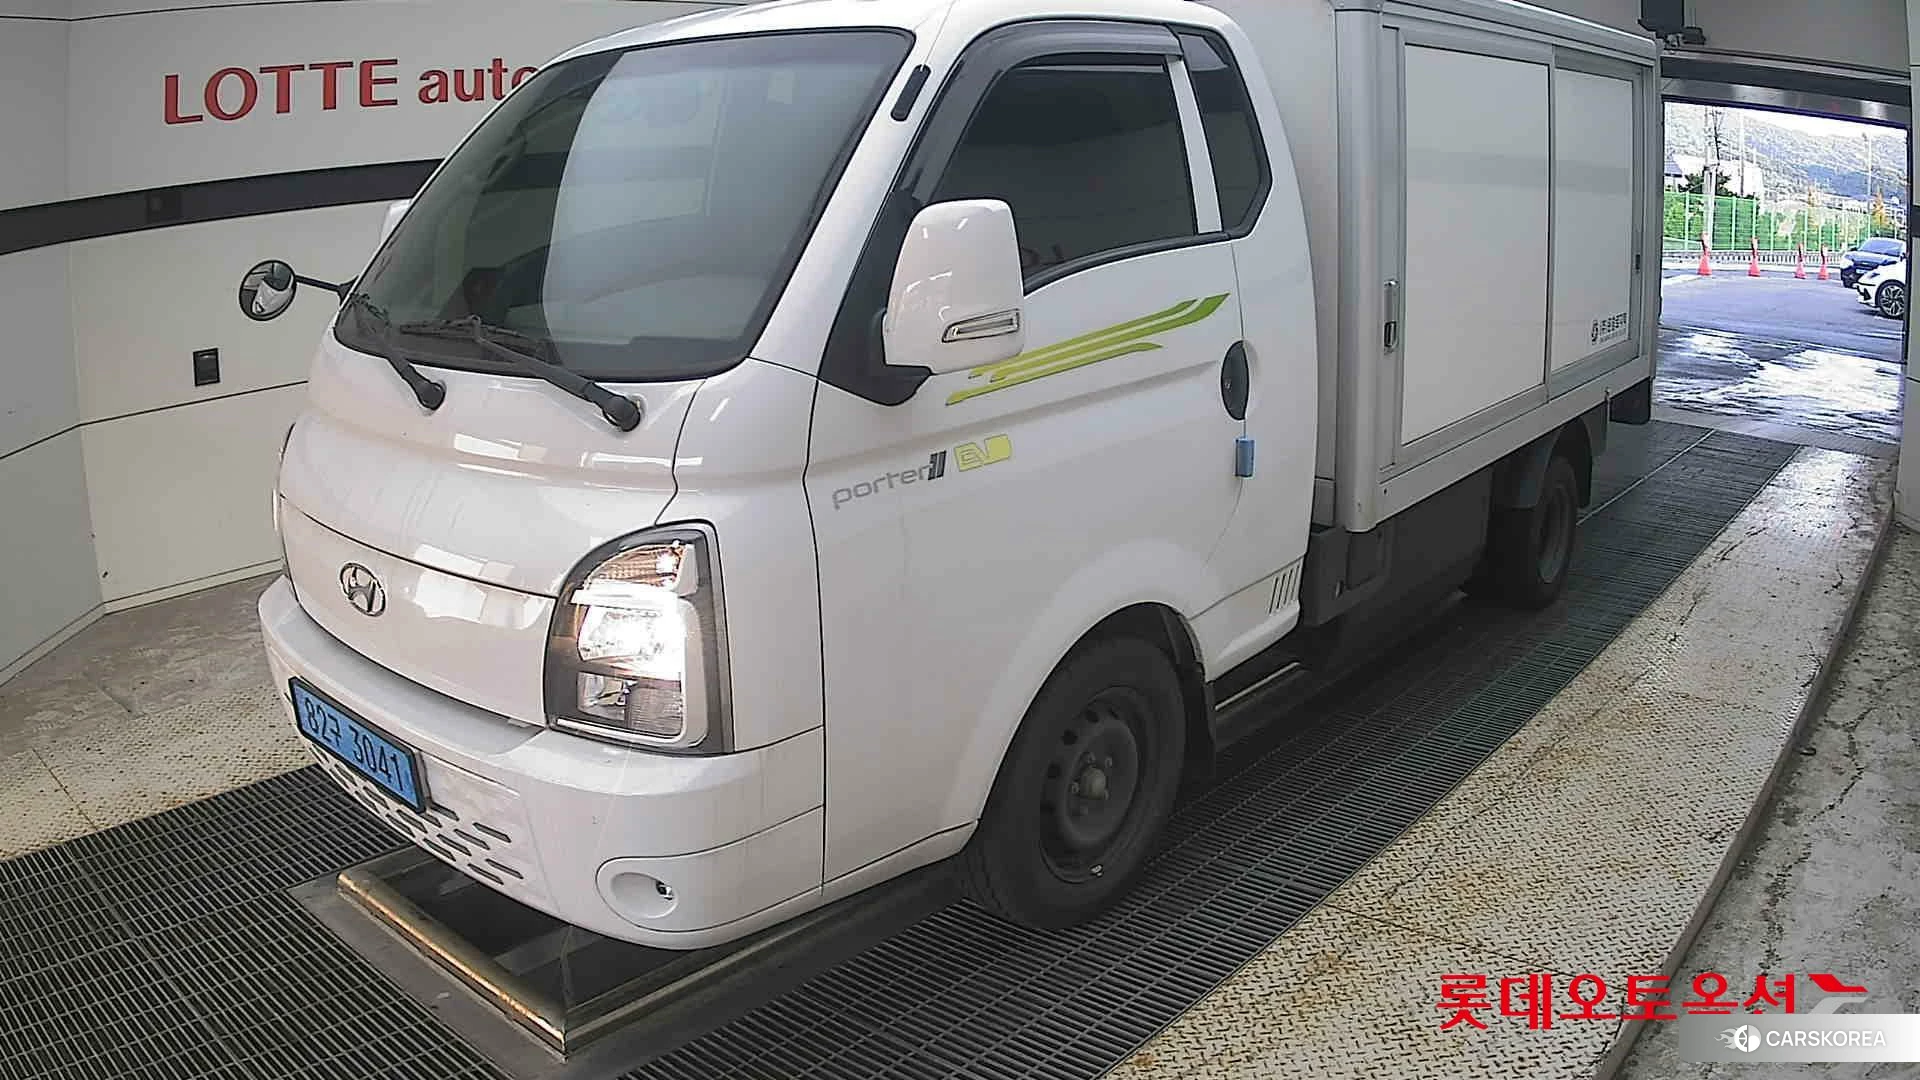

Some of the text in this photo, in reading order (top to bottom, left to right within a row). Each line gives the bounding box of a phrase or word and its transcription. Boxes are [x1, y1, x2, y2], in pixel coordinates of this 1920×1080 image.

[164, 58, 398, 125] LOTTE
[831, 464, 932, 510] porter
[348, 724, 404, 792] 3041
